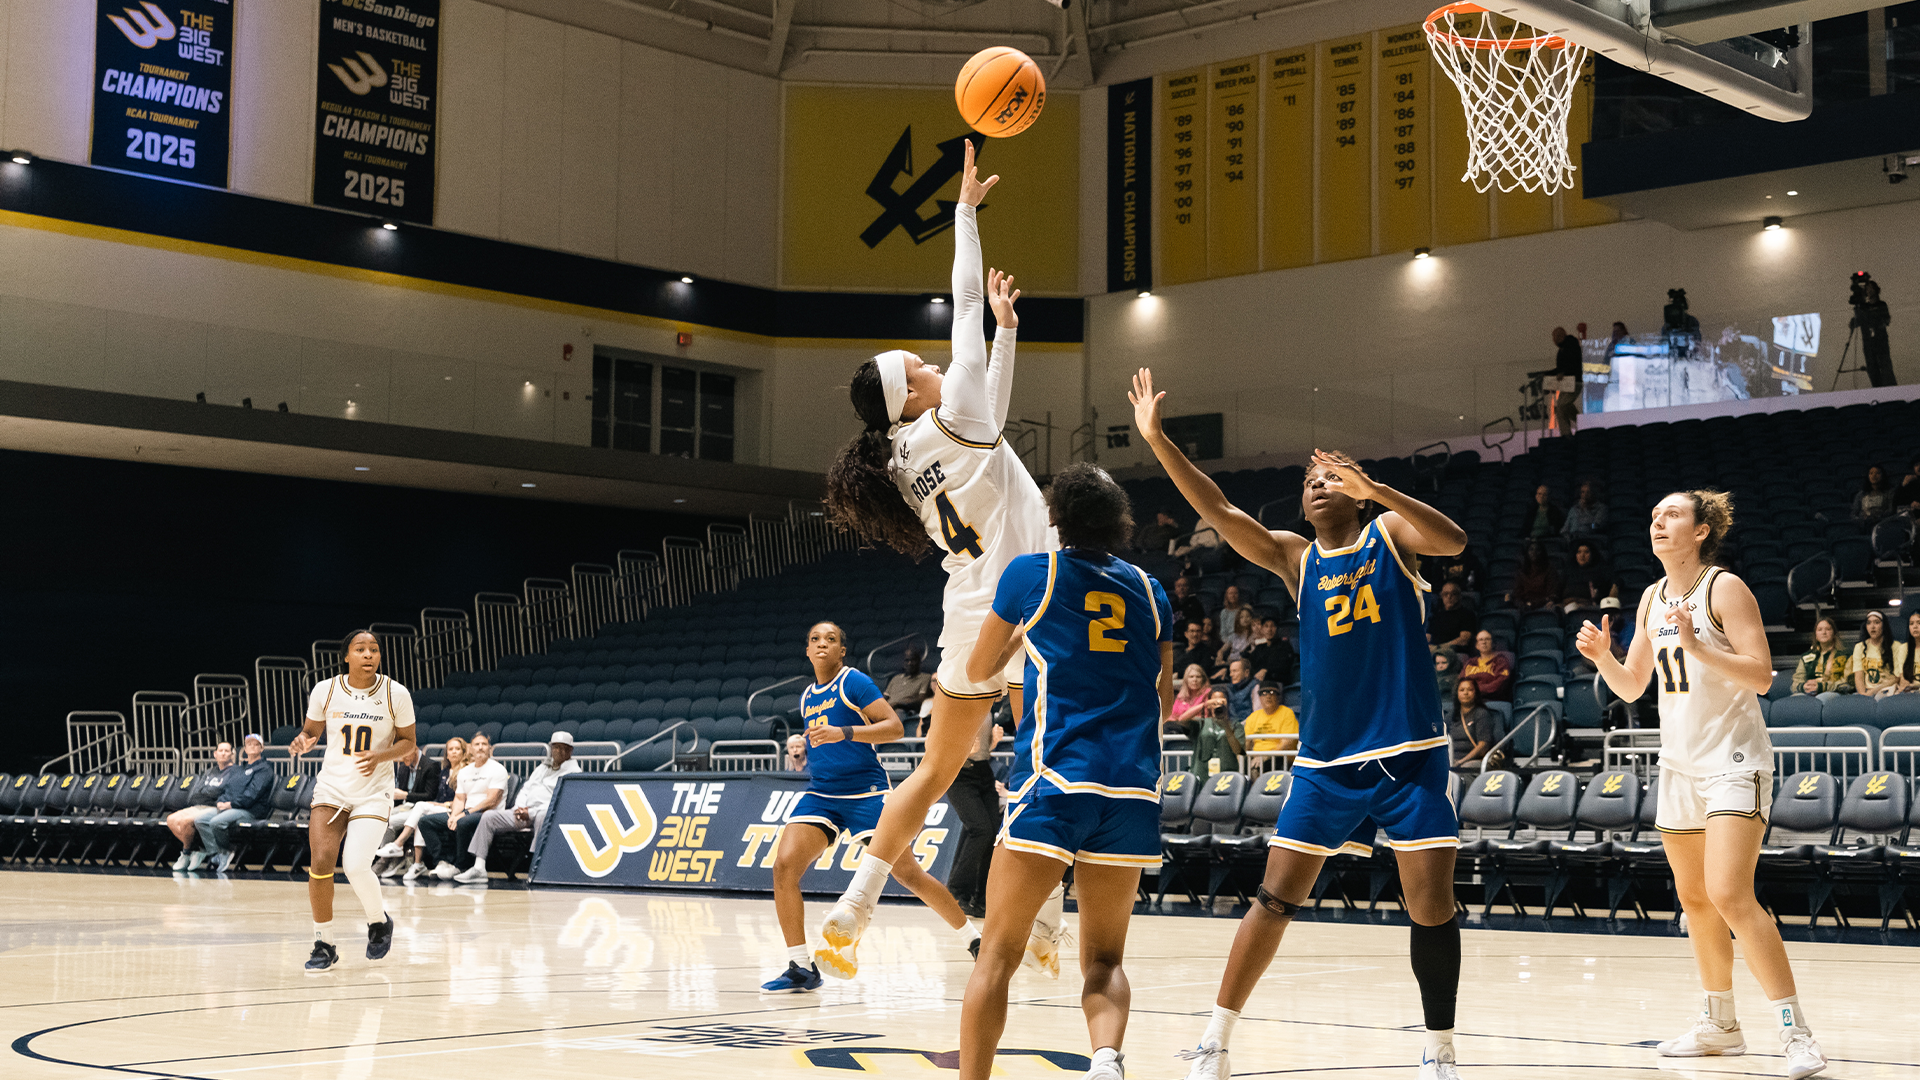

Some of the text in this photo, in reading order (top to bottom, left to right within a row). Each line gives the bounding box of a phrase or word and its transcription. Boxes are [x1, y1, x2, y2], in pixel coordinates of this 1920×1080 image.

[180, 10, 213, 32] THE
[179, 26, 211, 47] BIG
[333, 17, 427, 51] MEN'S BASKETBALL
[1387, 30, 1421, 45] WOMEN'S
[178, 43, 224, 66] WEST
[1330, 42, 1362, 55] WOMEN'S
[1381, 43, 1427, 59] VOLLEYBALL
[1274, 53, 1306, 67] WOMEN'S
[1333, 56, 1359, 68] TENNIS
[139, 62, 190, 81] TOURNAMENT
[391, 58, 421, 79] THE
[1220, 63, 1250, 76] WOMEN'S
[1273, 67, 1307, 80] SOFTBALL
[391, 74, 418, 93] BIG
[1215, 75, 1256, 90] WATER POLO
[1395, 73, 1413, 86] '81
[102, 68, 223, 114] CHAMPIONS
[1171, 88, 1196, 100] SOCCER
[1336, 83, 1356, 97] '85
[1393, 90, 1415, 103] '84
[389, 89, 430, 110] WEST
[1225, 103, 1244, 117] '86
[1336, 100, 1356, 114] '87
[1394, 106, 1415, 120] '86
[125, 107, 200, 129] NCAA TOURNAMENT
[321, 101, 352, 115] REGULAR
[353, 108, 381, 121] SEASON
[389, 115, 432, 132] TOURNAMENT
[1174, 114, 1192, 127] '89
[1225, 120, 1244, 133] '90
[1336, 117, 1356, 131] '89
[1394, 124, 1414, 138] '87
[322, 114, 429, 156] CHAMPIONS
[1174, 130, 1192, 143] '95
[1336, 134, 1356, 148] '94
[125, 127, 196, 169] 2025
[1226, 137, 1243, 150] '91
[1394, 141, 1415, 155] '88
[343, 150, 408, 171] NCAA TOURNAMENT
[1174, 147, 1192, 160] '96
[1225, 154, 1243, 167] '92
[1174, 163, 1192, 176] '97
[1394, 159, 1415, 172] '90
[1225, 170, 1244, 183] '94
[1394, 176, 1415, 190] '97
[344, 169, 405, 207] 2025
[1174, 180, 1192, 192] '99
[1123, 111, 1136, 282] NATIONAL CHAMPIONS
[1174, 196, 1192, 208] '00
[1175, 213, 1191, 225] '01
[910, 460, 947, 503] ROSE
[934, 488, 985, 560] 4
[1324, 583, 1382, 637] 24
[1084, 591, 1129, 653] 2
[1656, 645, 1689, 694] 11
[340, 723, 373, 756] 10
[671, 783, 725, 814] THE
[656, 815, 711, 848] BIG
[647, 849, 725, 883] WEST
